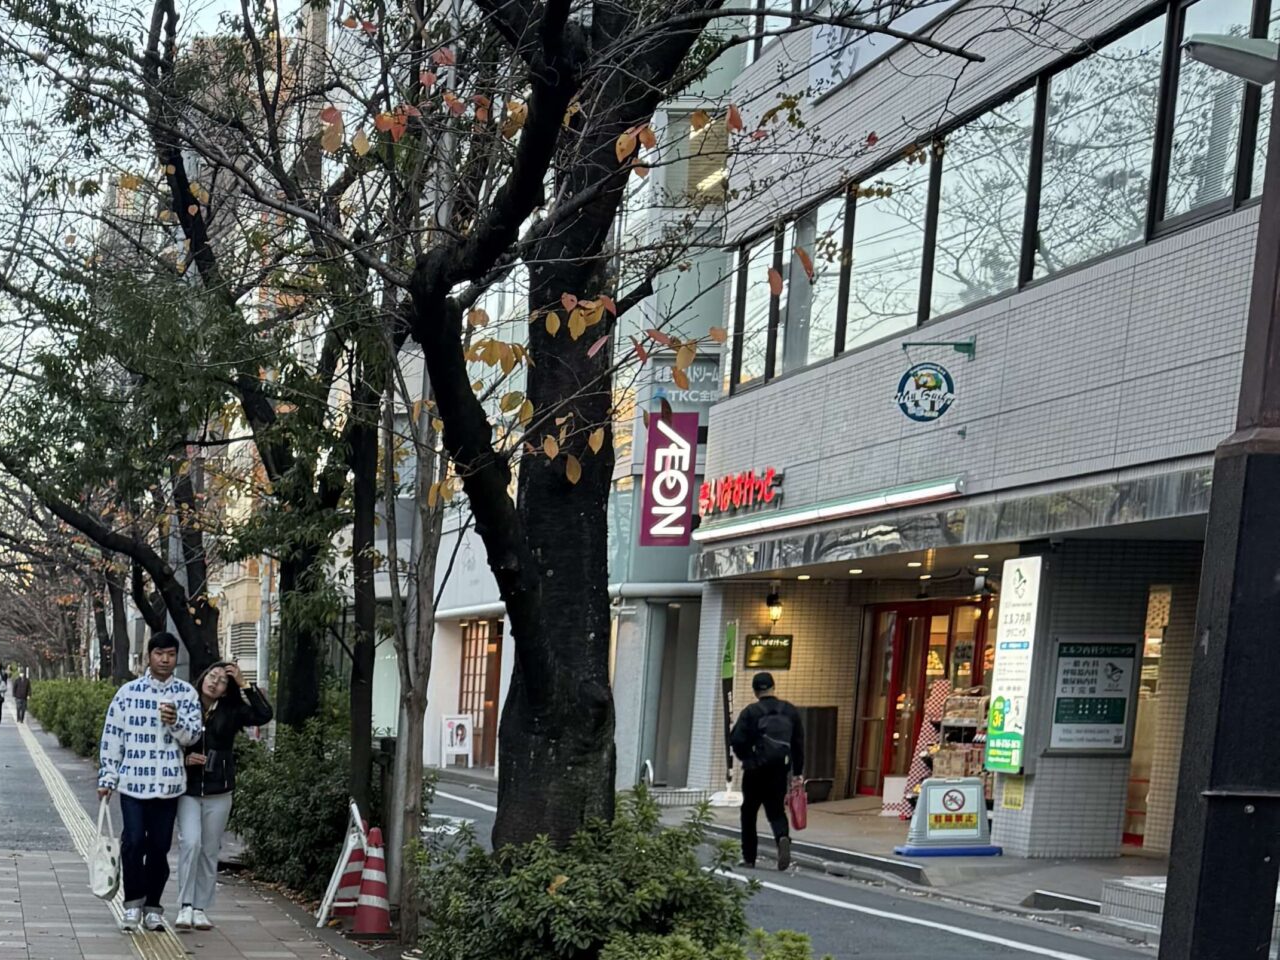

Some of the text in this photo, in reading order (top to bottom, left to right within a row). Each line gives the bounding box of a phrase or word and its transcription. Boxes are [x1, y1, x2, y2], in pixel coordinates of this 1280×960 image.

[649, 419, 691, 535] AEON
[127, 749, 147, 760] GAP
[133, 766, 156, 776] 1969
[127, 782, 146, 794] GAP
